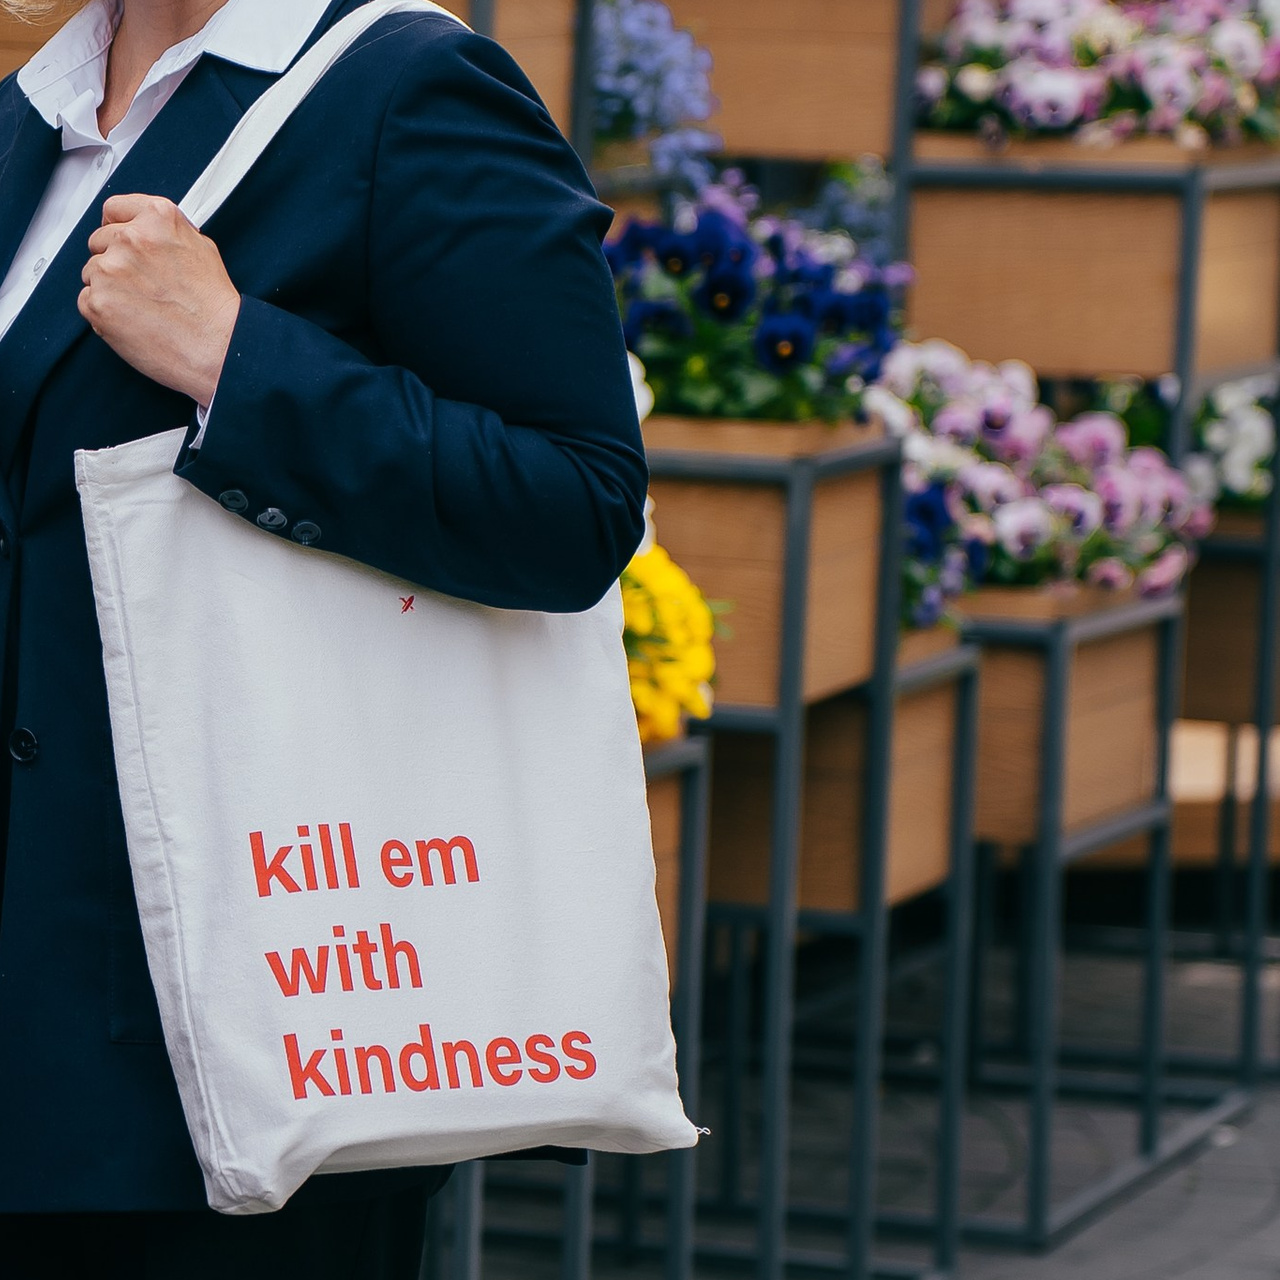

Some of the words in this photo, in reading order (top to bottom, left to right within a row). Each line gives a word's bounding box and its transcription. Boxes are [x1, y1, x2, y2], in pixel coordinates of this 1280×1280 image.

[249, 822, 360, 898] kill
[380, 835, 480, 889] em
[264, 922, 423, 998] with
[283, 1023, 597, 1100] kindness
